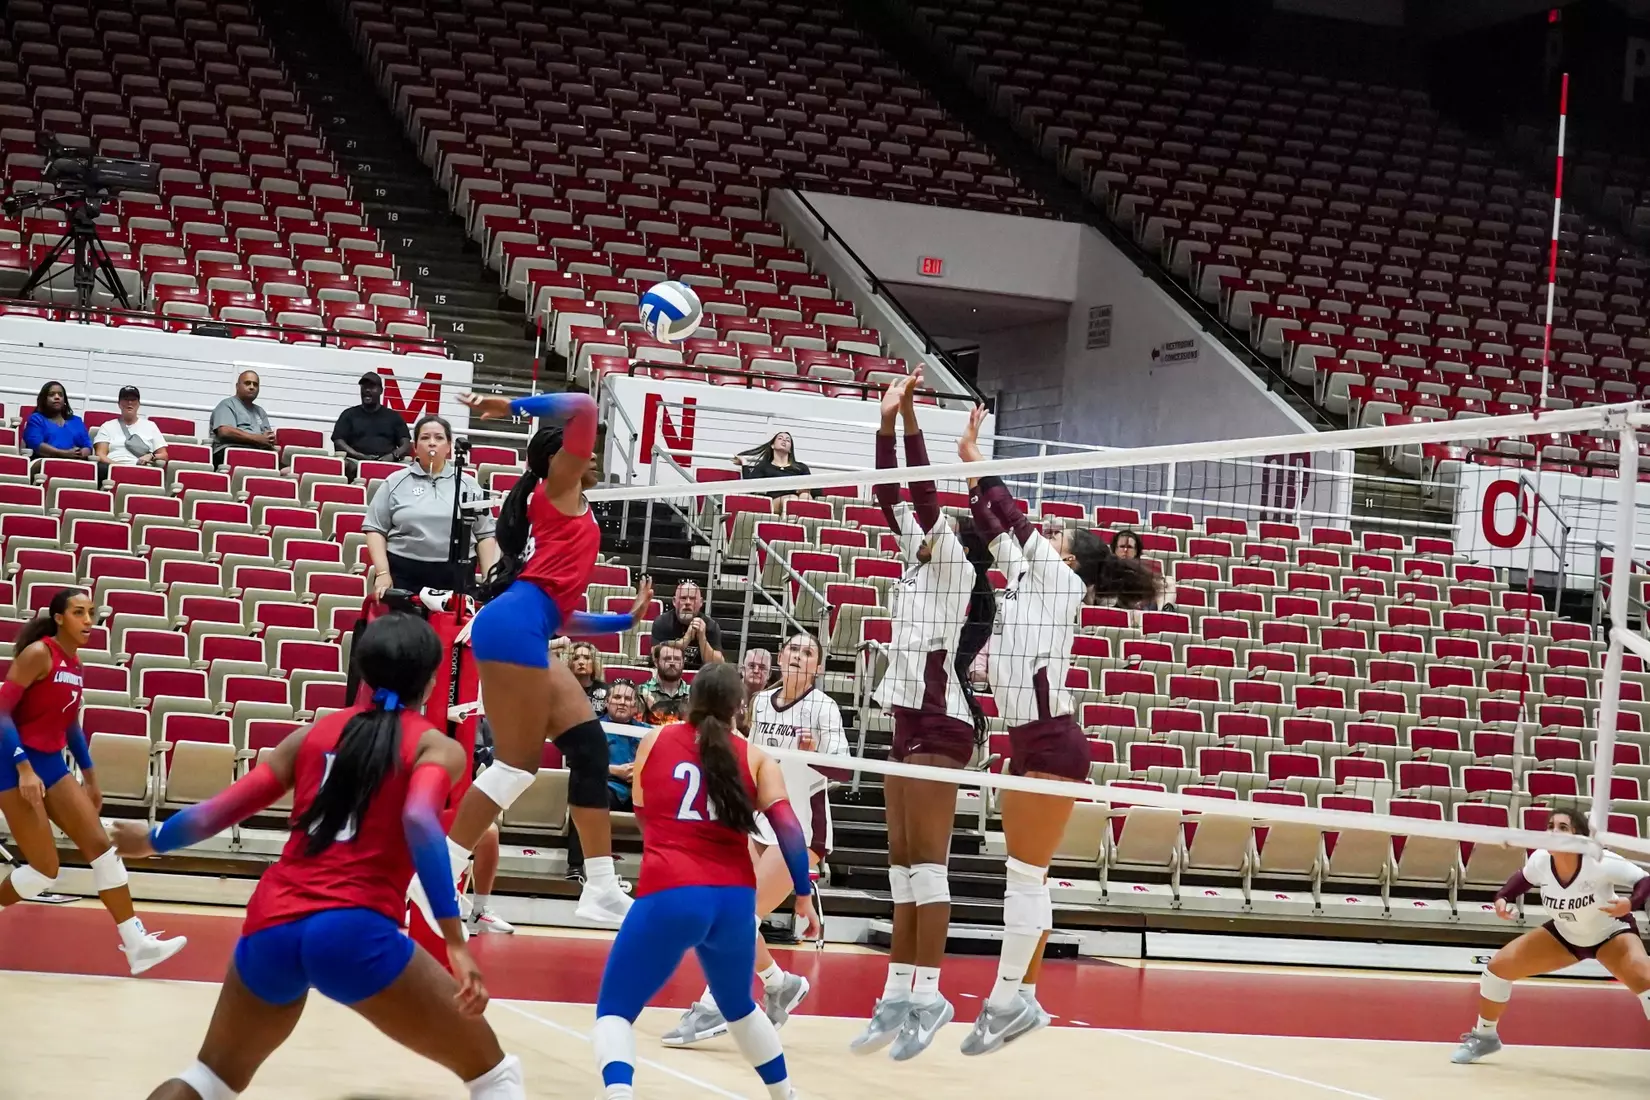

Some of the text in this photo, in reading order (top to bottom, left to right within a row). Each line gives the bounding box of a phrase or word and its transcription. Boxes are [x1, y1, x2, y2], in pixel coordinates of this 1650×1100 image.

[346, 140, 357, 148] 21
[358, 164, 371, 172] 20
[375, 188, 386, 196] 19
[388, 212, 398, 221] 18
[402, 238, 413, 247] 17
[923, 257, 943, 274] EXIT
[418, 267, 429, 276] 16
[435, 295, 446, 304] 15
[452, 323, 464, 332] 14
[473, 353, 484, 362] 13
[377, 367, 443, 424] M
[512, 415, 521, 424] 11
[639, 393, 697, 468] N
[1365, 498, 1373, 508] 11
[775, 724, 796, 737] ROCK
[1568, 894, 1595, 910] ROCK
